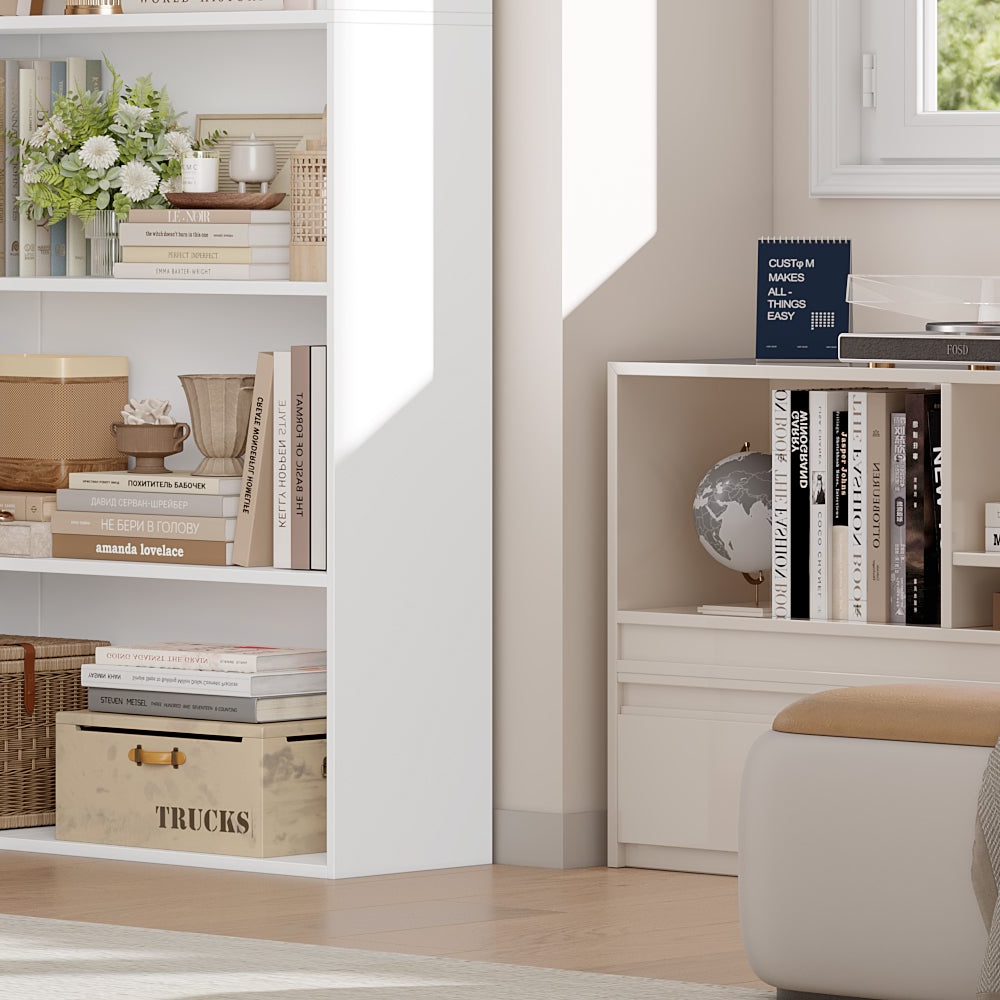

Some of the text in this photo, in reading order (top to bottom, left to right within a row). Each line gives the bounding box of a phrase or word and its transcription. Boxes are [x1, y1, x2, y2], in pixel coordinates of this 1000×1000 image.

[168, 210, 210, 222] LE NOIR
[768, 273, 805, 282] MAKES
[768, 288, 786, 296] ALL
[768, 300, 806, 308] THINGS
[767, 312, 795, 320] EASY
[946, 343, 969, 356] FOSD
[128, 480, 173, 488] ПОХИТИТЕЛЬ
[174, 482, 206, 490] БАБОЧЕК
[90, 497, 188, 510] ДАВИД СЕРВАН-ШРЕЙБЕР
[101, 519, 114, 531] НЕ
[117, 520, 144, 532] БЕРИ
[148, 521, 154, 532] В
[157, 521, 200, 534] ГОЛОВУ
[96, 542, 184, 557] amanda lovelace
[101, 697, 147, 707] STEVEN MEISEL
[155, 806, 250, 834] TRUCKS
